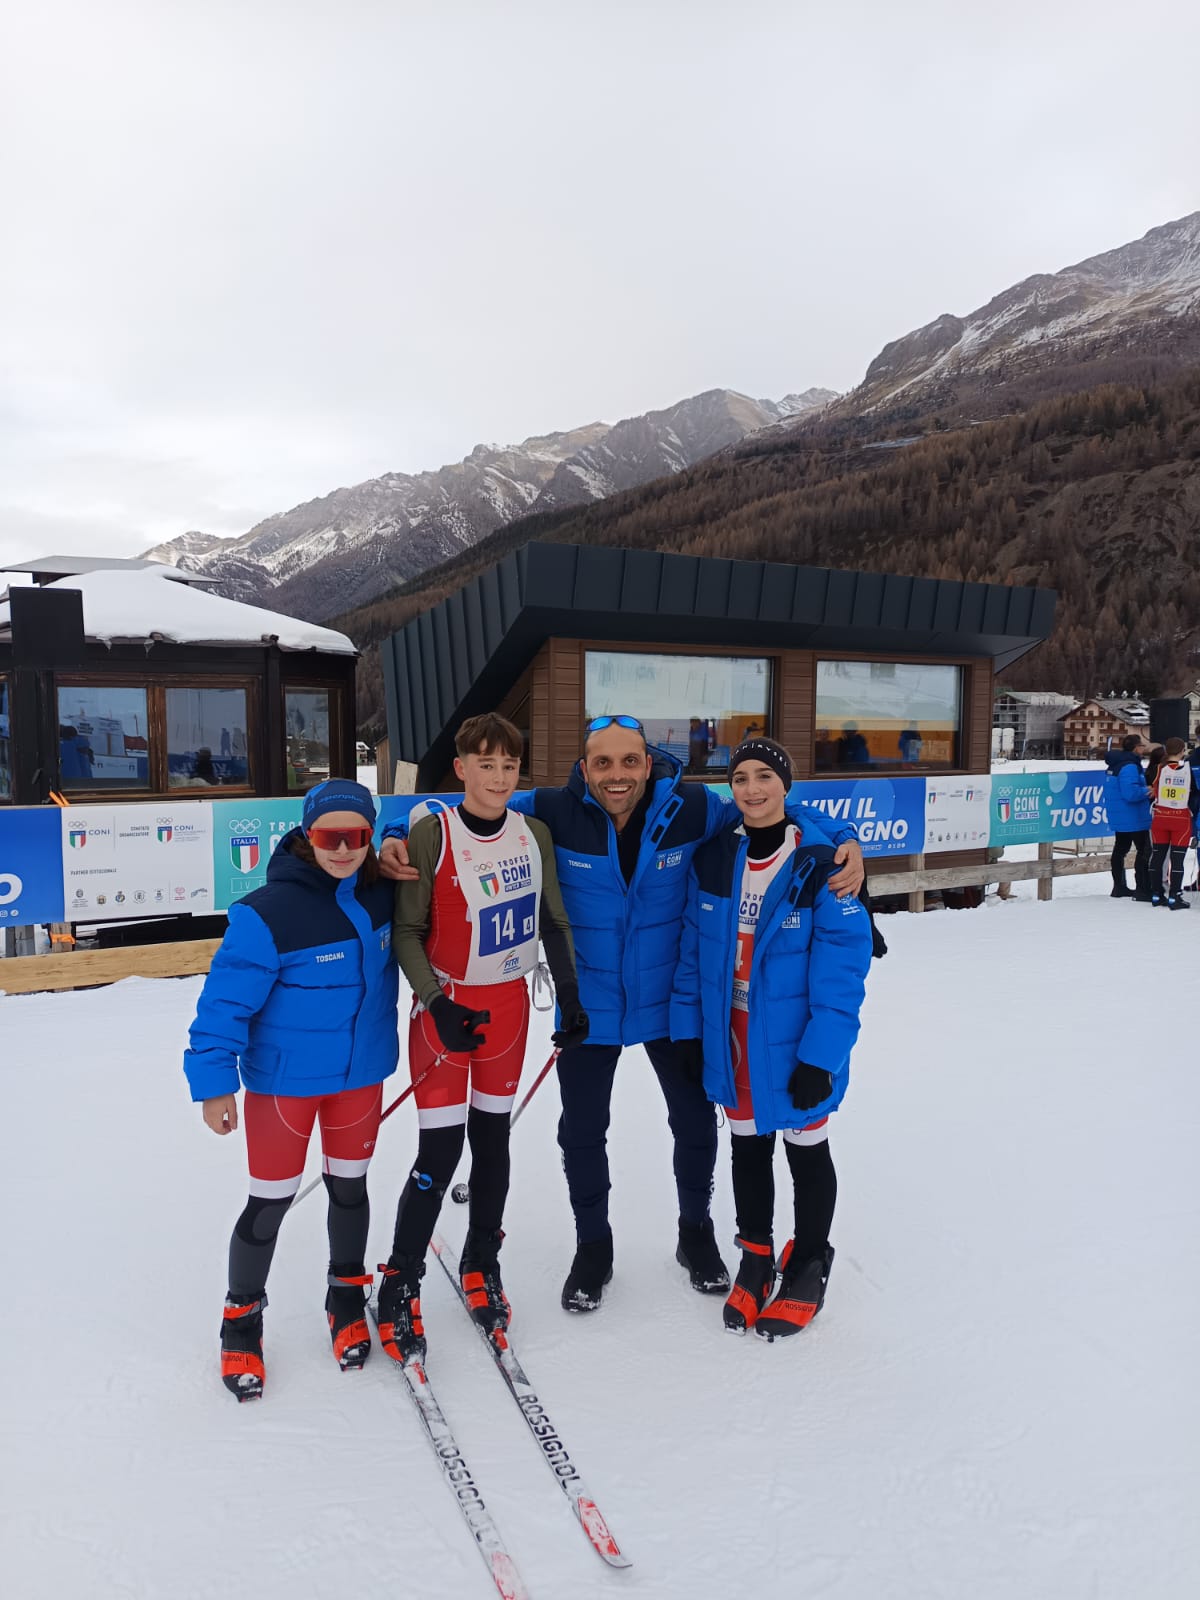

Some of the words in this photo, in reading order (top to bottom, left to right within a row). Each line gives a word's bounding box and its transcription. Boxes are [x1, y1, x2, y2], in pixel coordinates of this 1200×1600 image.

[1165, 788, 1177, 798] 18
[855, 797, 877, 819] IL
[1014, 795, 1039, 812] CONI
[1050, 807, 1087, 828] TUO
[88, 828, 111, 836] CONI
[847, 818, 909, 843] GNO
[232, 838, 257, 846] ITALIA
[497, 855, 530, 868] TROFEO
[567, 859, 593, 869] TOSCANA
[501, 863, 531, 884] CONI
[739, 900, 758, 916] CO
[491, 908, 516, 946] 14
[315, 951, 345, 963] TOSCANA
[516, 1394, 581, 1490] ROSSIGNOL
